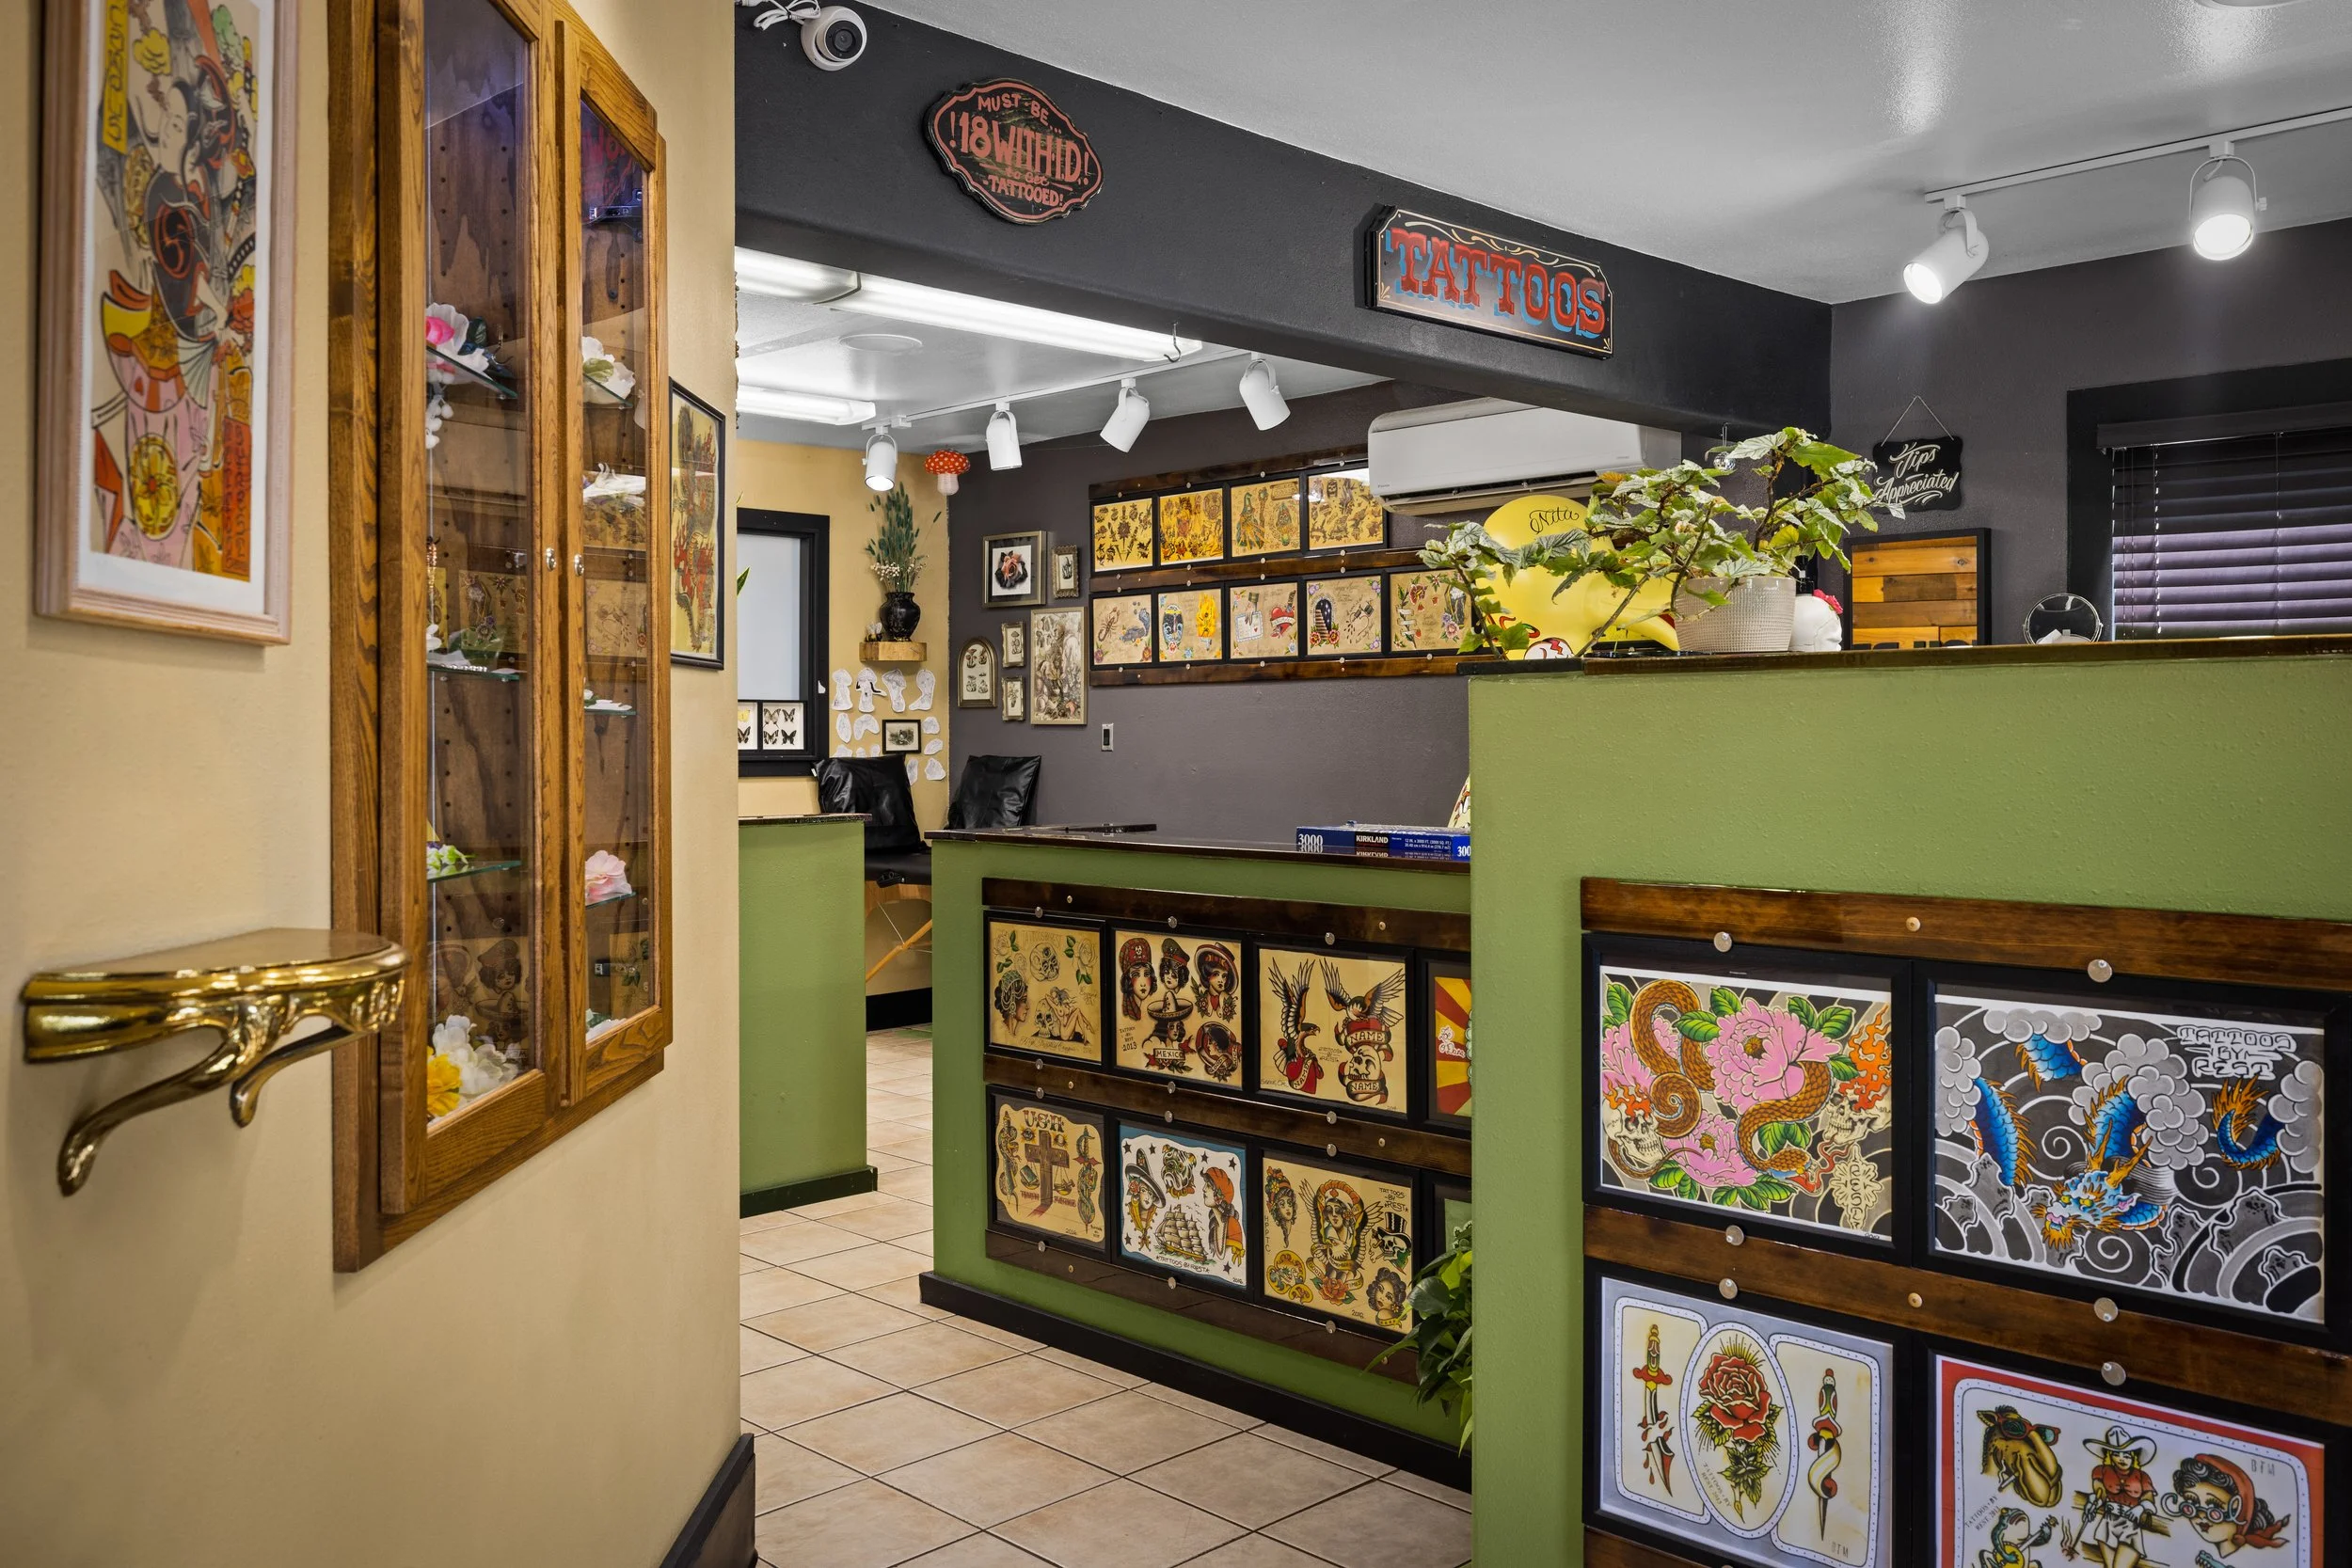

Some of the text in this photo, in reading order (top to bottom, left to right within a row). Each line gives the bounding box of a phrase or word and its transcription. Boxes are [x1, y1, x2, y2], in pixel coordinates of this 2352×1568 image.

[977, 93, 1022, 112] MUST
[992, 119, 1054, 178] WITH
[988, 175, 1064, 207] TATTOOED!
[1386, 228, 1606, 338] TATTOOS
[1889, 442, 1941, 478] Tips
[1875, 469, 1959, 503] Appreciated
[1298, 833, 1324, 846] 3000
[1356, 834, 1389, 844] KIRKLAND
[1349, 1031, 1384, 1044] NAME
[2180, 1025, 2292, 1050] TATTOOS
[2218, 1046, 2244, 1060] BY
[2194, 1058, 2270, 1078] REST
[1351, 1082, 1378, 1091] NAME
[1379, 1187, 1406, 1198] TATTOOS
